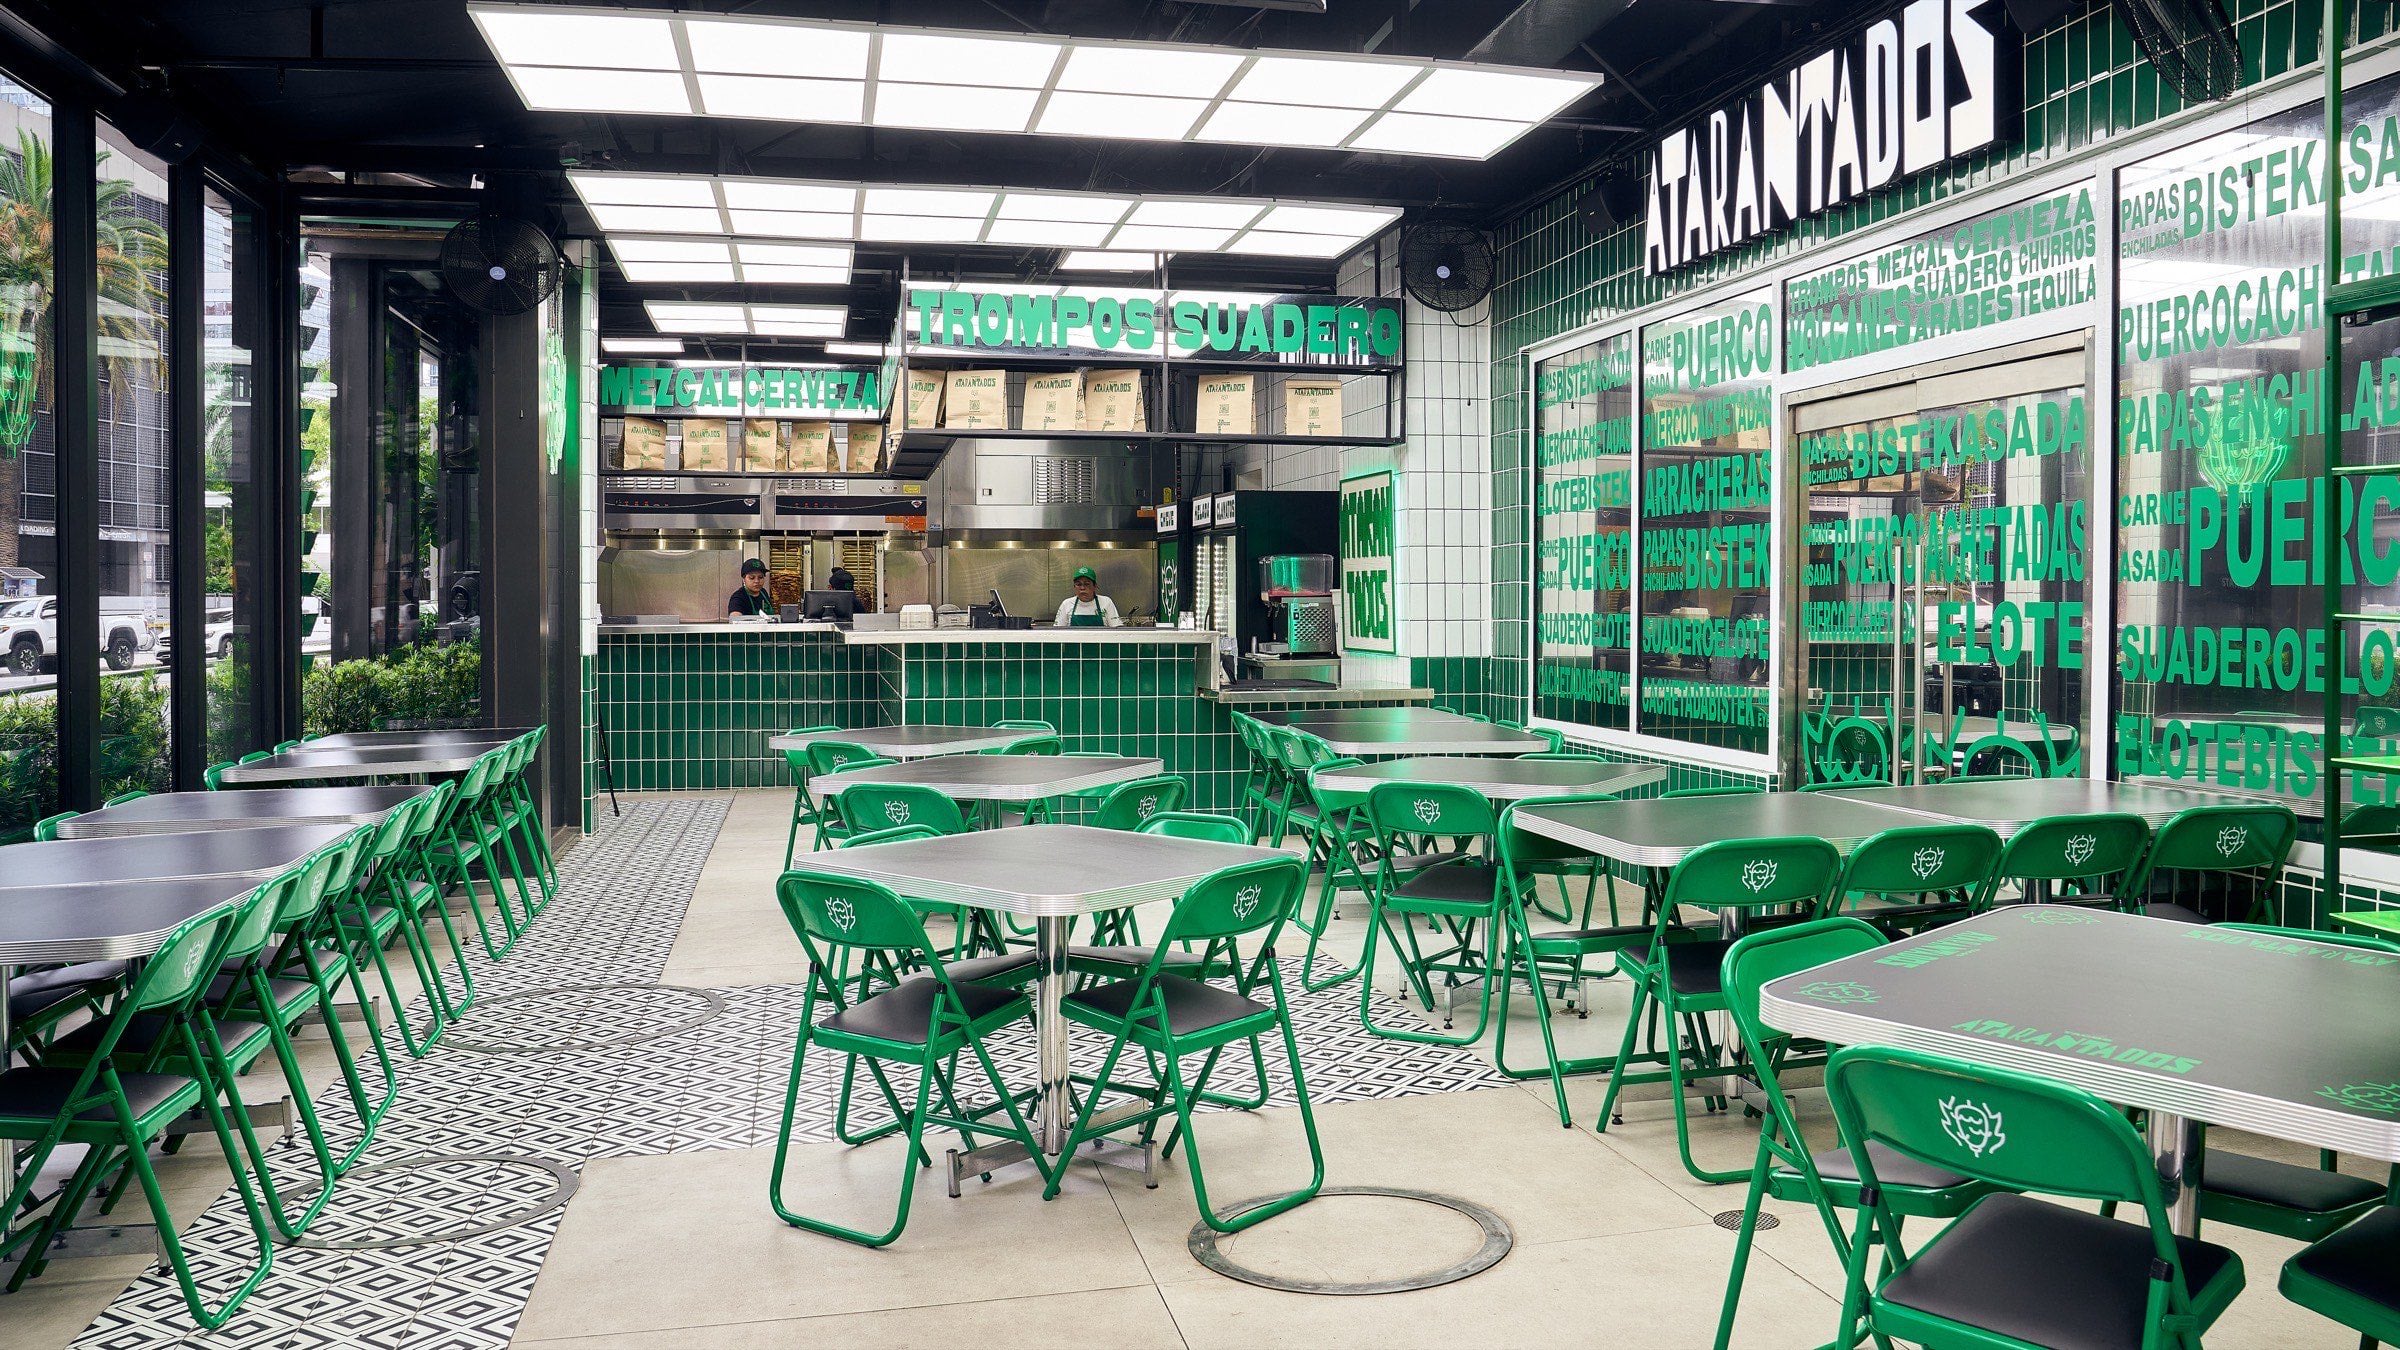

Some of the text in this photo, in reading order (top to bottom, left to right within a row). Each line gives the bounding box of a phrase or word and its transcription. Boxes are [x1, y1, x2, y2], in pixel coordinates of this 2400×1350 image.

[1644, 0, 1994, 278] ATARANTADOS
[2121, 183, 2180, 233] PAPAS
[1789, 187, 2094, 313] TROMPOS MEZCAL CERVEZA
[2121, 227, 2179, 260] ENCHILADAS
[911, 290, 1400, 356] TROMPOS SUADERO
[1787, 224, 2096, 372] VOLCANES SUADERO CHURROS
[1914, 263, 2096, 342] ARABES TEQUILA
[1645, 303, 1772, 393] CARNE PUERCO
[601, 366, 880, 411] MEZCAL CERVEZA
[2120, 356, 2400, 456] PAPAS ENCHIAD
[1538, 415, 1631, 468] PUERCOCACHETADAS
[1643, 384, 1772, 450] PUERCOCACHETADAS
[1801, 396, 2085, 480] PAPAS BISTEKASADA
[1538, 470, 1631, 516] ELOTEBISTEK
[1643, 450, 1772, 518] ARRACHERAS
[2120, 490, 2186, 528] CARNE
[21, 524, 48, 533] LOADING
[1802, 522, 1832, 547] CARNE
[1559, 530, 1631, 591] PUERCO
[1643, 523, 1772, 591] PAPAS BISTEK
[1643, 571, 1684, 591] ENCHILADAS
[2119, 549, 2184, 582] ASADA
[1538, 612, 1631, 649] SUADEROELOTE
[1642, 616, 1769, 660] SUADEROELOTE
[1937, 601, 2083, 669] ELOTE
[1538, 665, 1621, 706] CACHETADABISTEK
[2120, 624, 2400, 697] SUADEROELO
[1642, 677, 1754, 726] CACHETADABISTEK
[1951, 1019, 2203, 1075] ATARANTADOS
